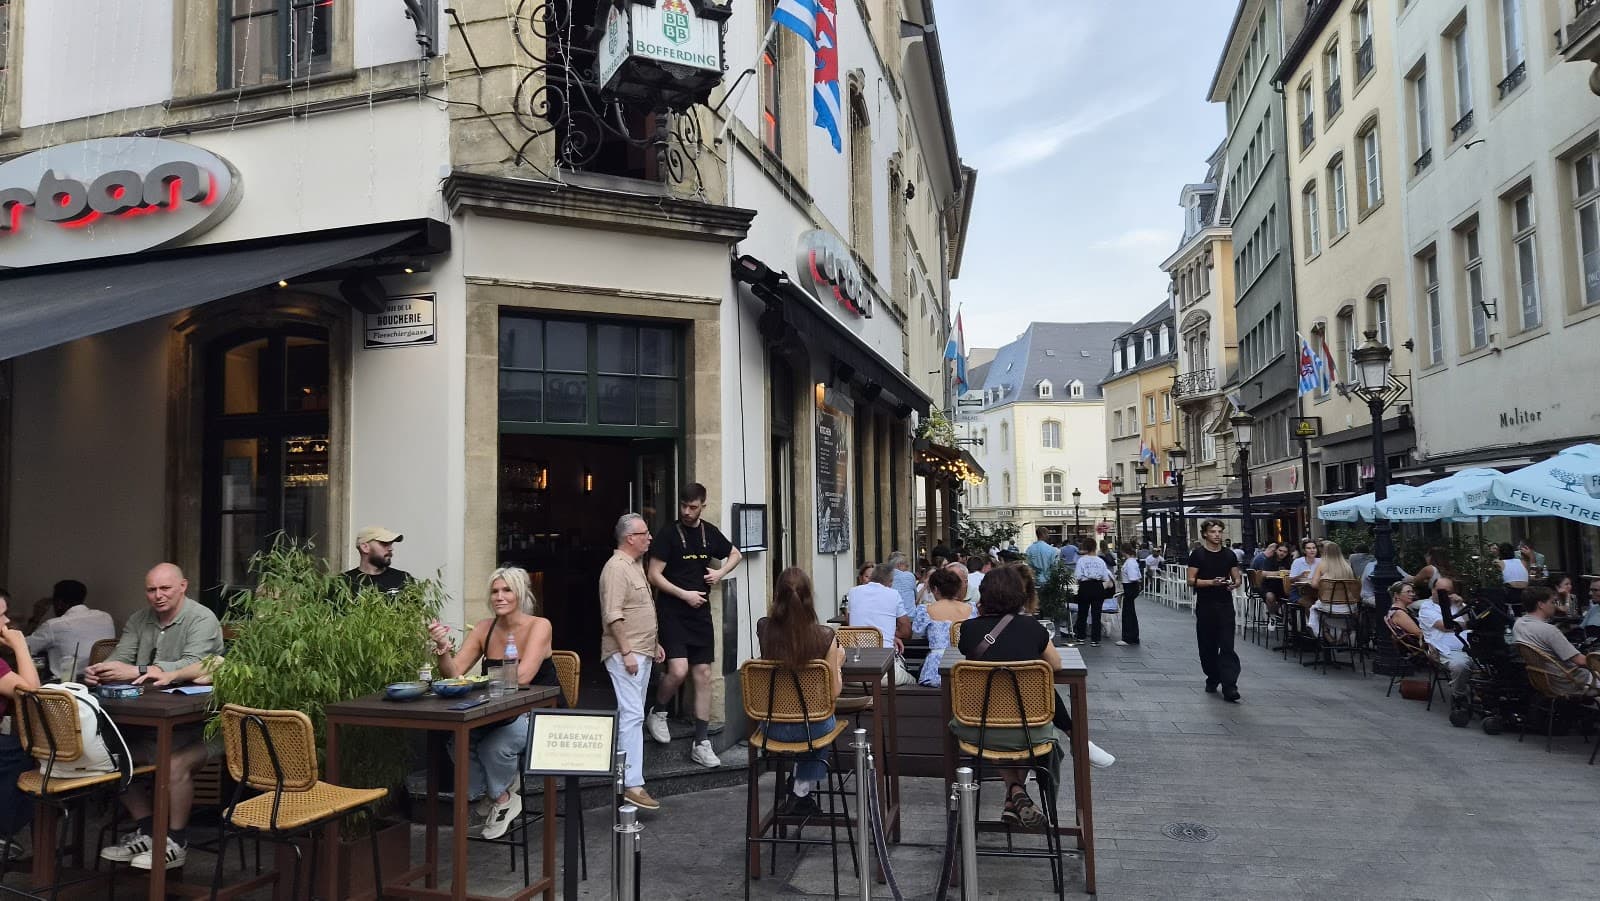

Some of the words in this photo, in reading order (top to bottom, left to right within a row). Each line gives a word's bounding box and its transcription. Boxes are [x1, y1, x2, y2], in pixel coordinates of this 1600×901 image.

[636, 40, 717, 67] BOFFERDING
[377, 312, 422, 327] BOUCHERIE
[1499, 407, 1542, 429] Molitor
[548, 732, 580, 740] PLEASE
[546, 740, 558, 748] TO
[560, 740, 571, 748] BE
[572, 741, 604, 749] SEATED
